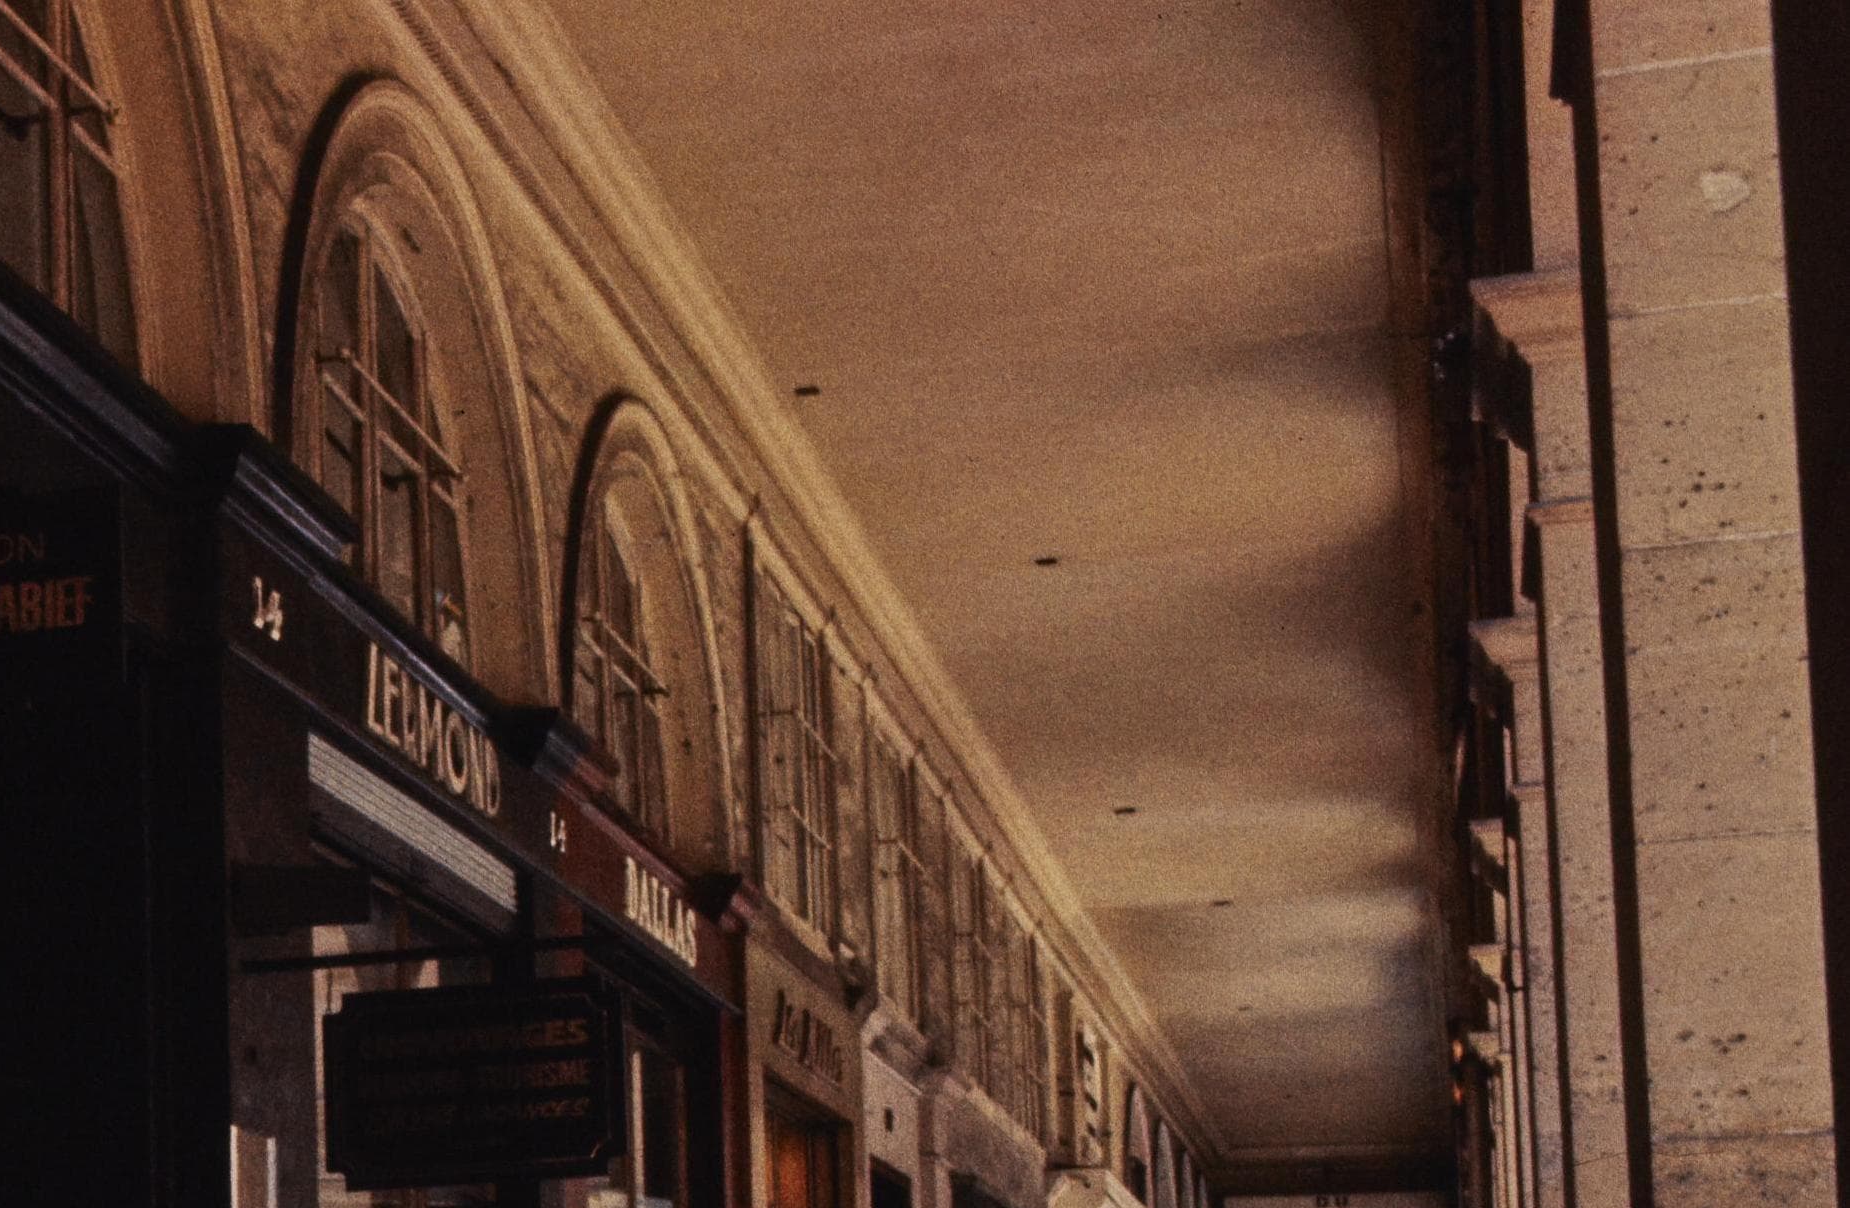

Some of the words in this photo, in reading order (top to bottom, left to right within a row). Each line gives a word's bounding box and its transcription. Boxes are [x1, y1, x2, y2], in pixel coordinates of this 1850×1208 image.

[252, 576, 283, 641] 14
[550, 811, 567, 853] 14
[624, 855, 697, 968] DALLAS
